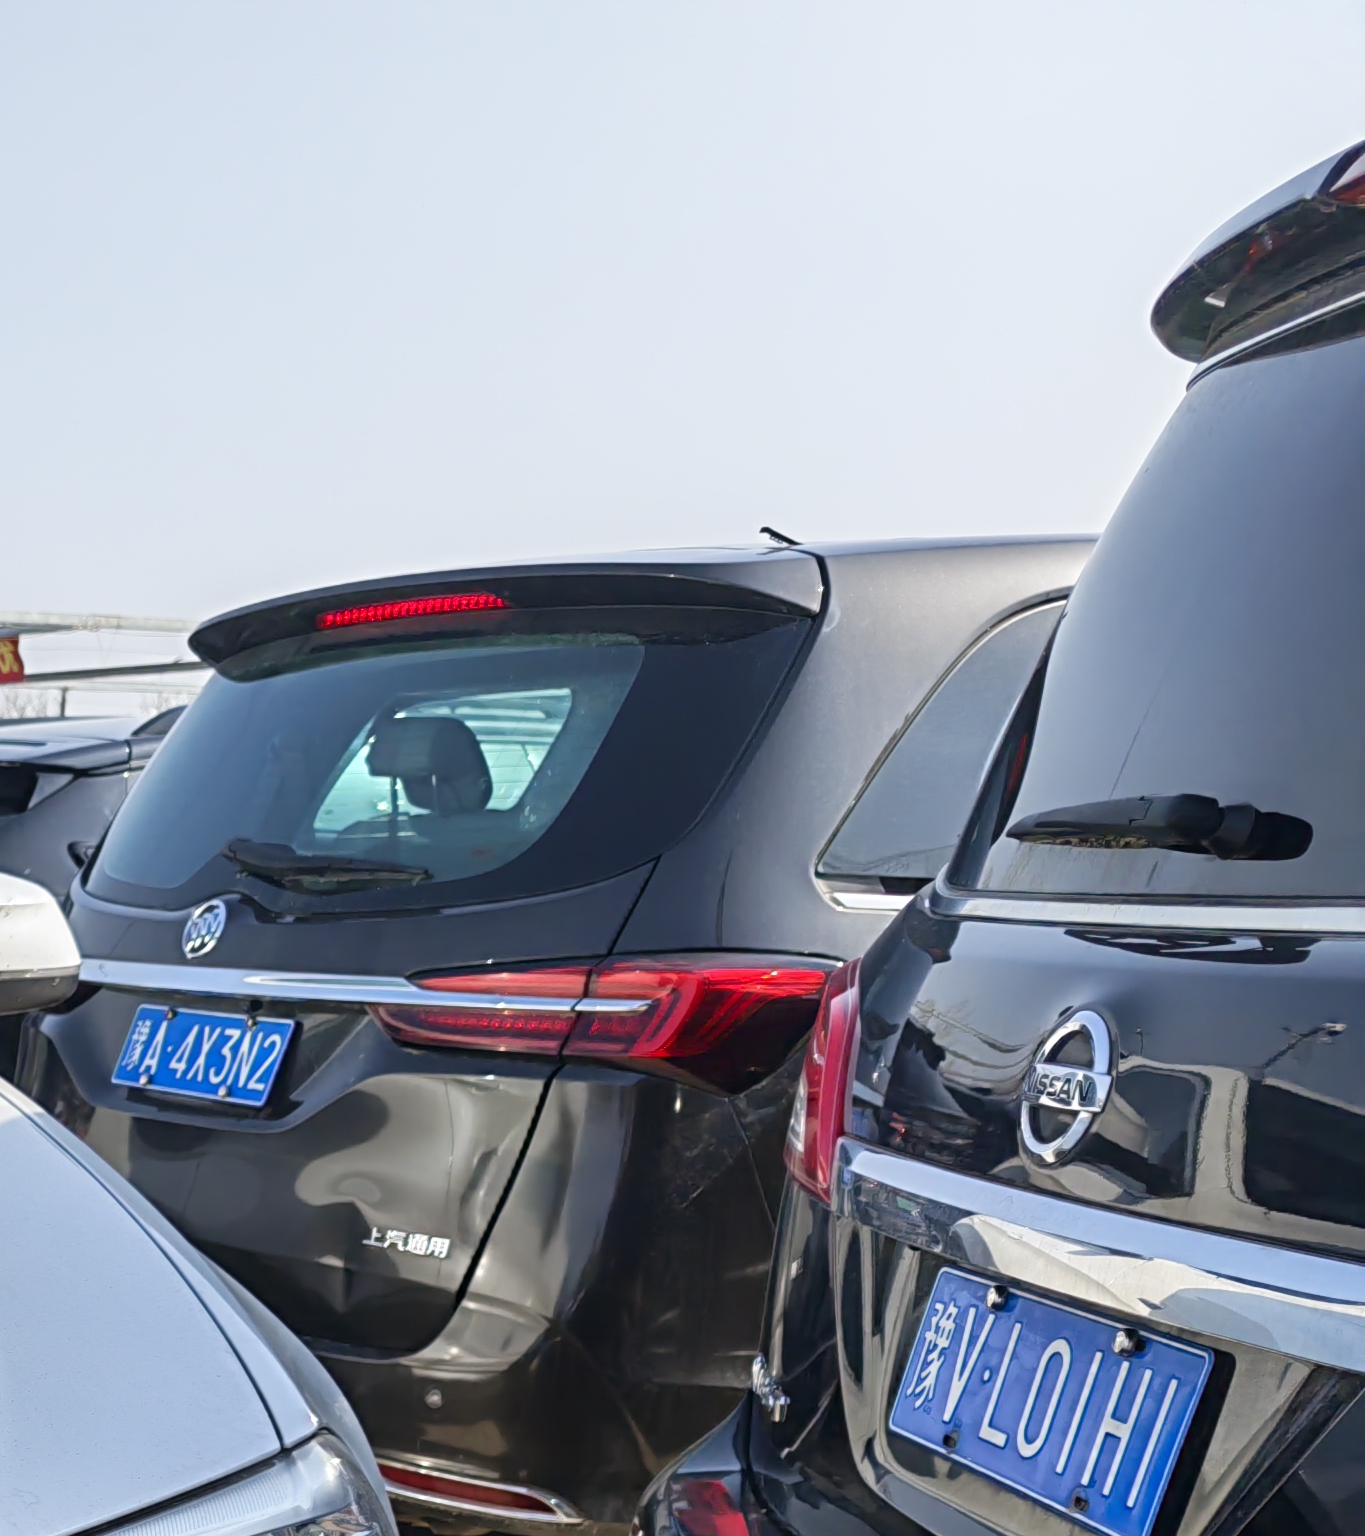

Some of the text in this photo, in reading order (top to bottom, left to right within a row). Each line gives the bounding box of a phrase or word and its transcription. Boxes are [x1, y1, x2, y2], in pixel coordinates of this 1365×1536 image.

[1023, 1072, 1092, 1103] NISSAN
[362, 1227, 451, 1259] 上汽通用
